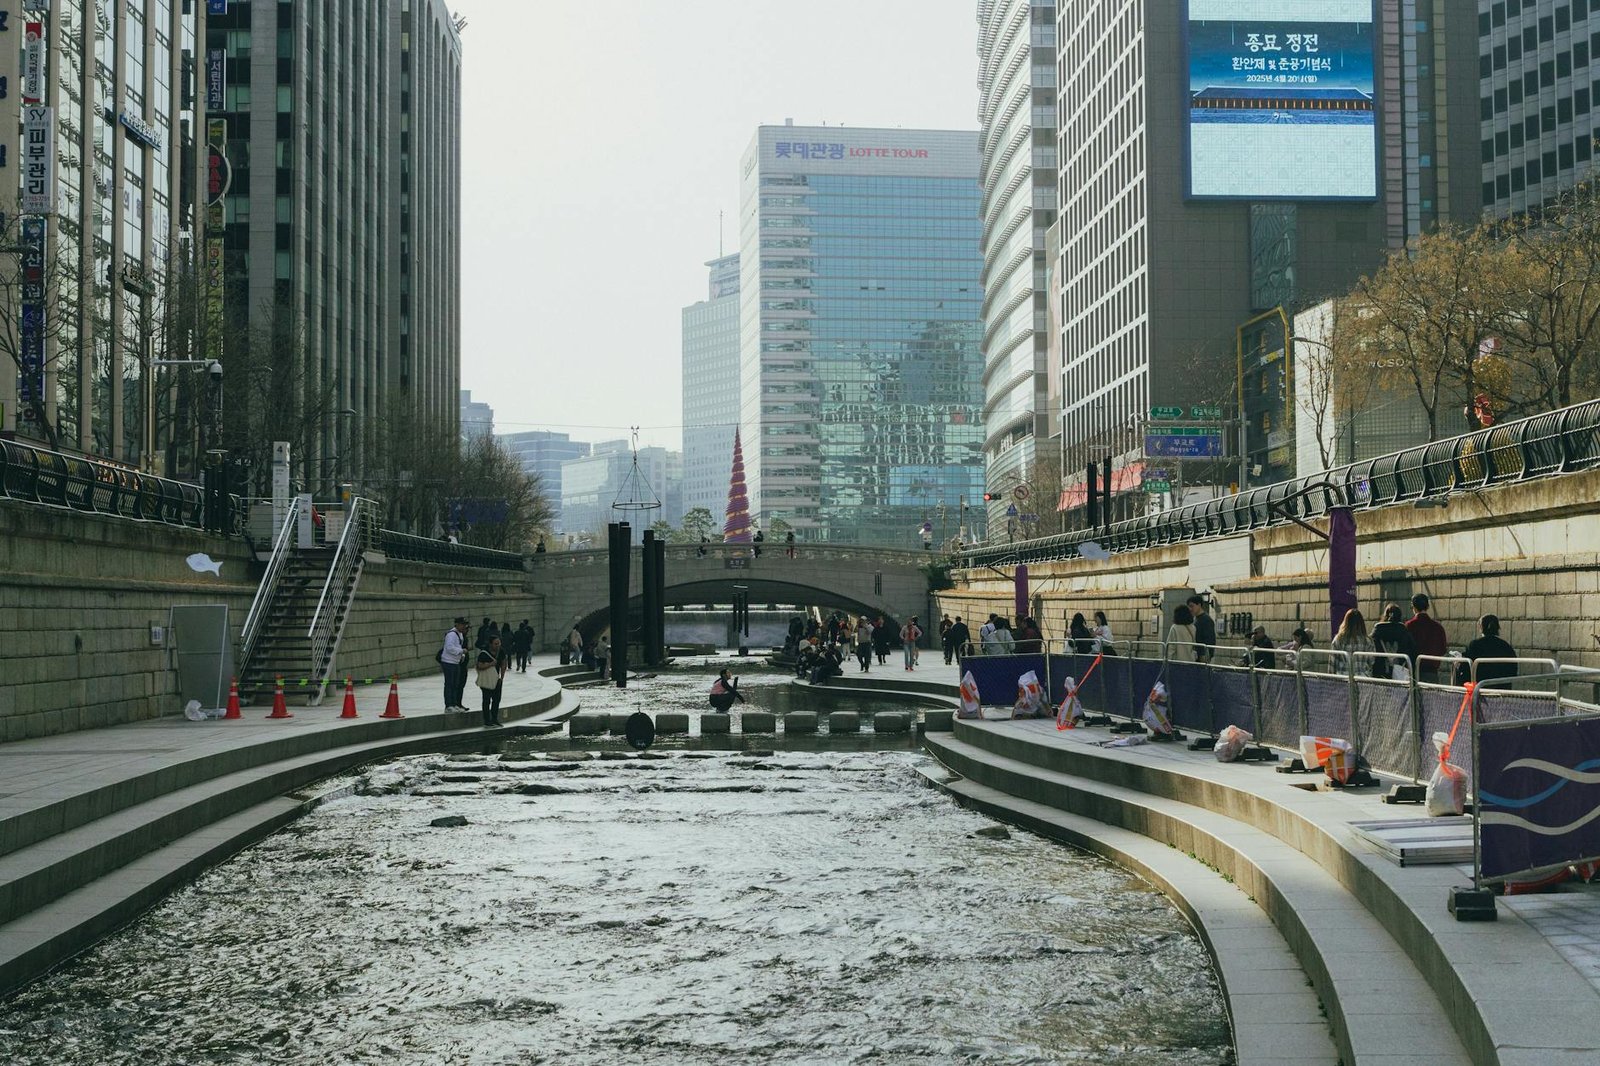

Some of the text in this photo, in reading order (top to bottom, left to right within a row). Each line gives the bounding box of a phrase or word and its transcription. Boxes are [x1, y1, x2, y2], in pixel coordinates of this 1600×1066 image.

[1245, 33, 1319, 52] 종묘 정전
[1231, 57, 1331, 71] 환안제 및 준공기념식
[1246, 74, 1273, 83] 2025년
[1273, 74, 1286, 83] 4월
[30, 109, 46, 121] SY
[775, 142, 845, 159] 롯데관광
[849, 147, 928, 159] LOTTE TOUR
[28, 128, 46, 195] 피부관리
